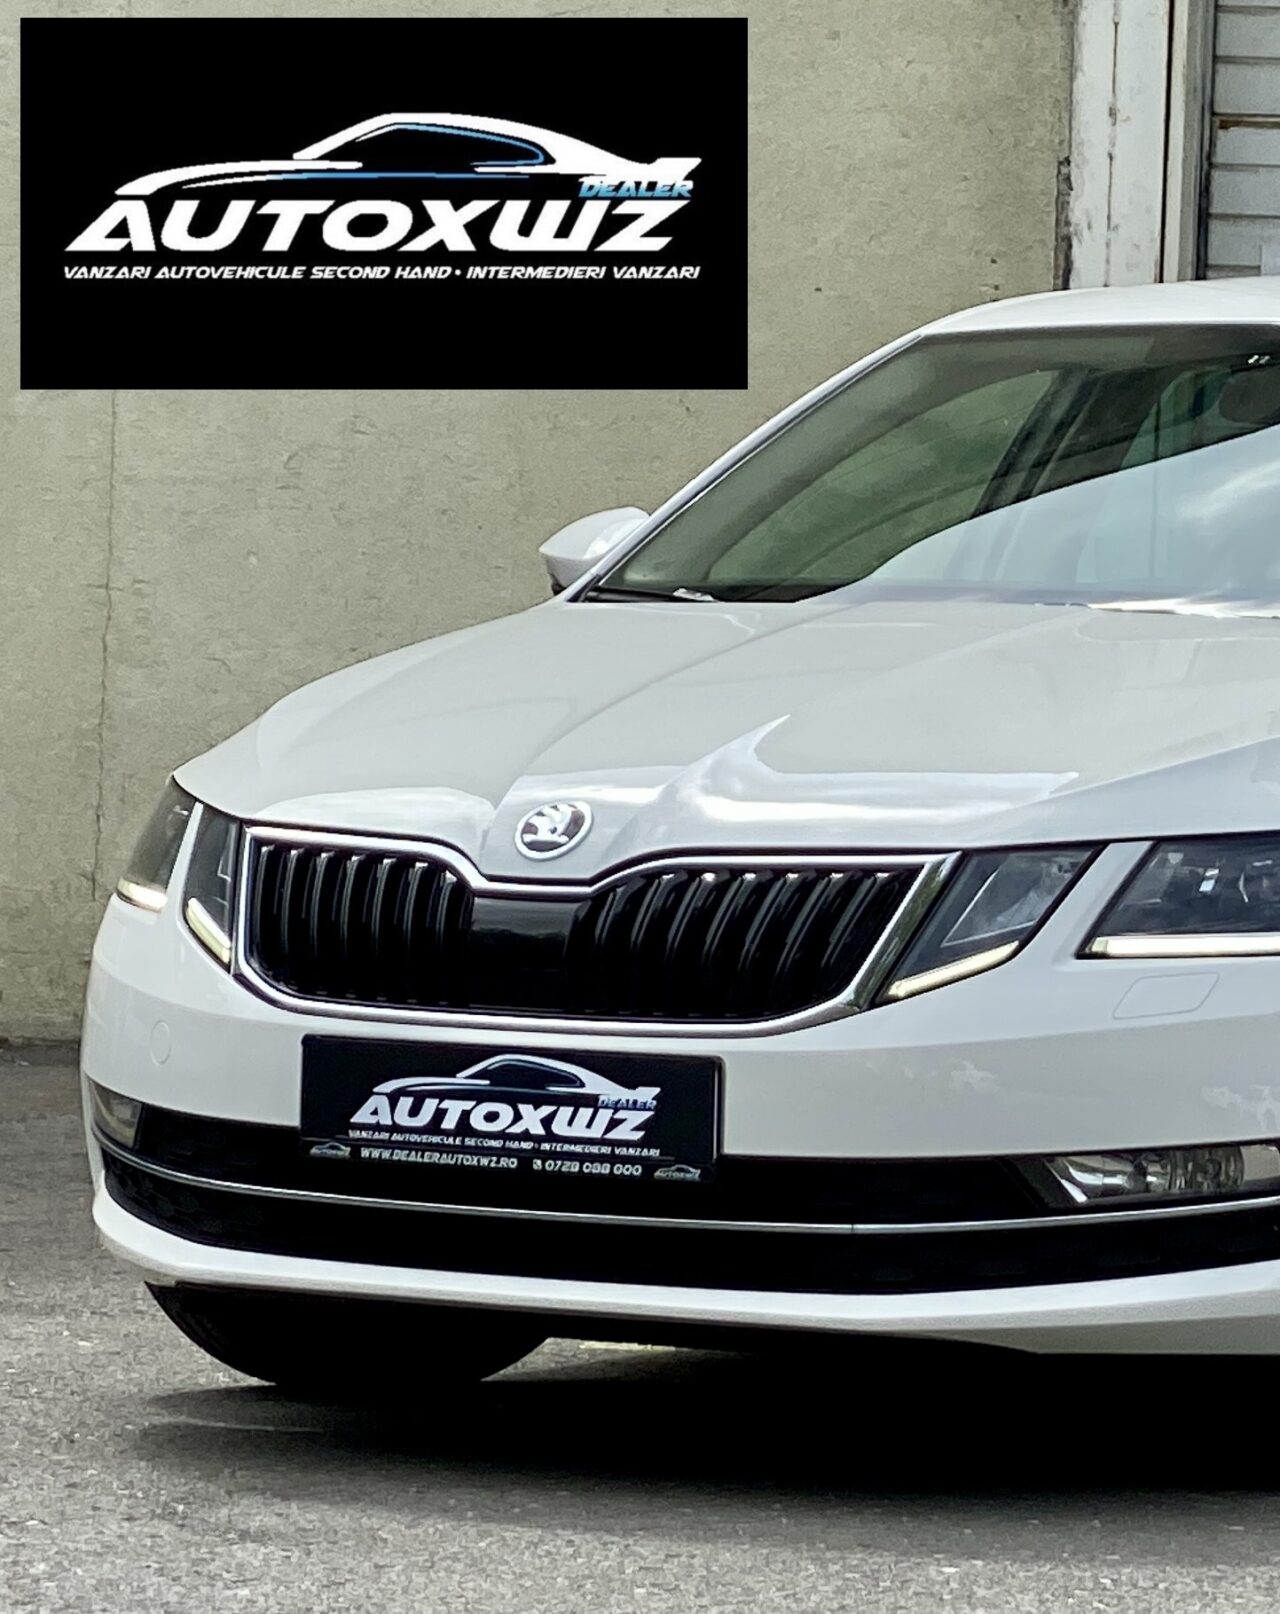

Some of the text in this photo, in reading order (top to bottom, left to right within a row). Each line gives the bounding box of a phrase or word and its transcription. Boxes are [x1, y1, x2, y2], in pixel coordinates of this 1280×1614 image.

[597, 1096, 658, 1110] DEALER
[350, 1094, 655, 1141] AUTOXWZ
[349, 1129, 661, 1157] VANZARI AUTOVEHICULE SECOND HAND INTERMEDIERI VANZARI
